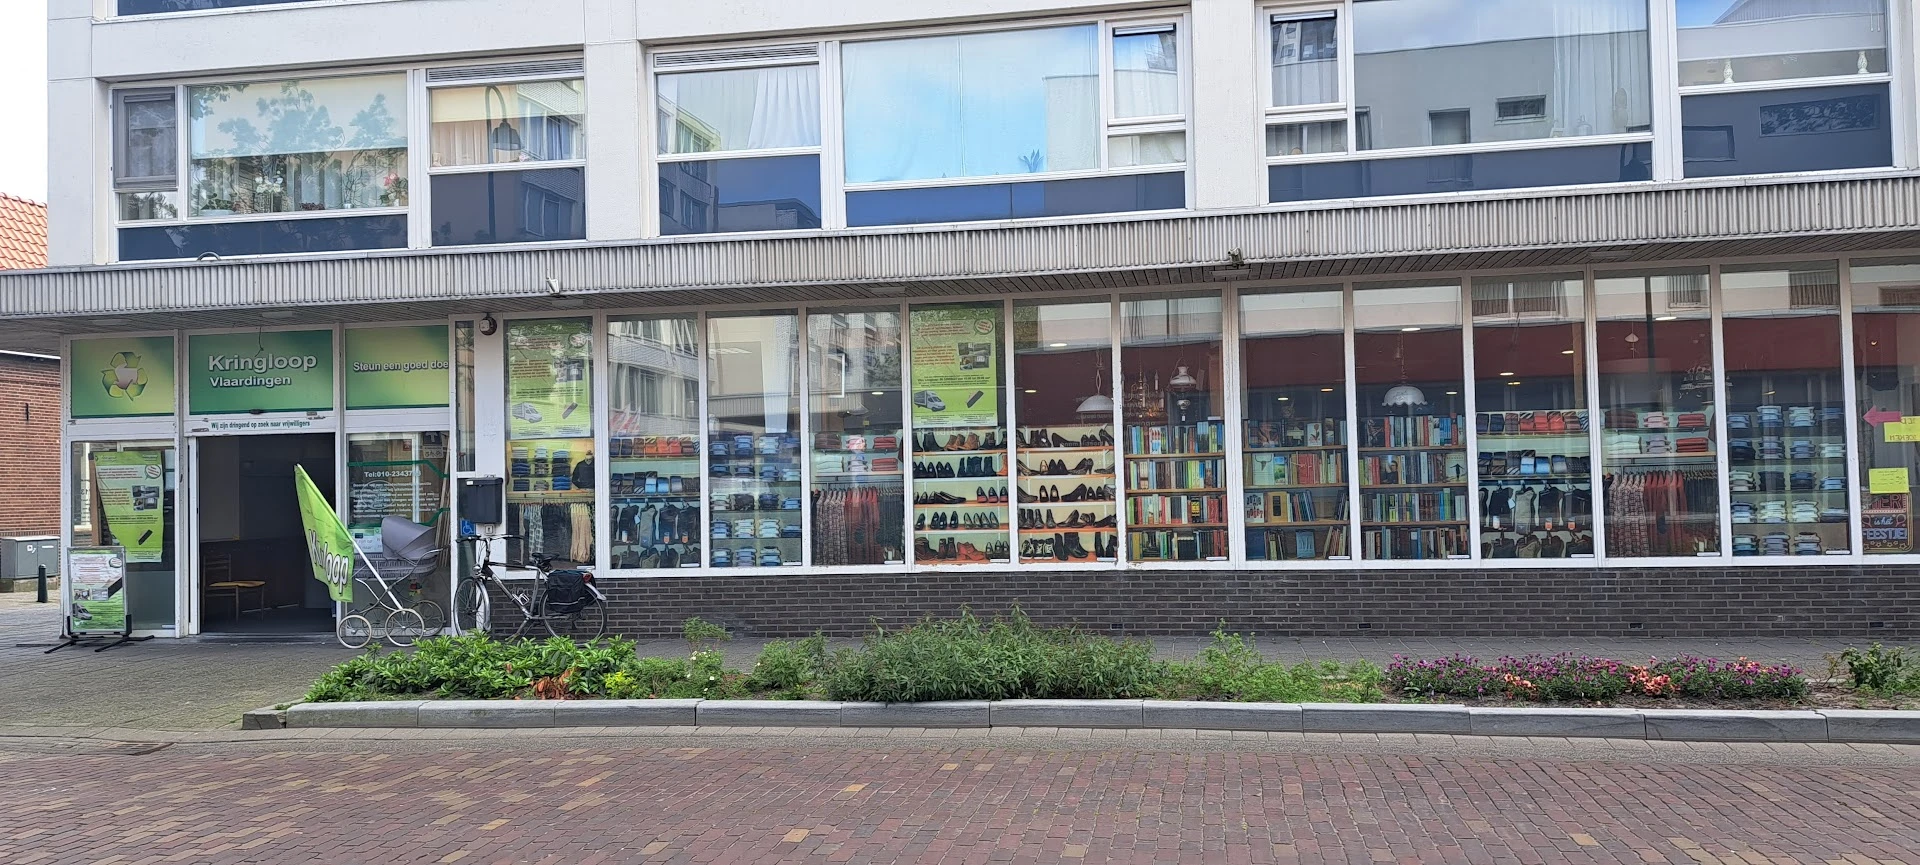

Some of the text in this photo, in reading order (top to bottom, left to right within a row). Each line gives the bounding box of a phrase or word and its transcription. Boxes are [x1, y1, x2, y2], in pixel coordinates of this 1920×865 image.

[208, 353, 317, 373] Kringloop
[353, 361, 381, 371] Steun
[383, 362, 401, 370] een
[403, 360, 428, 372] goed
[209, 375, 291, 388] Vlaardingen
[211, 422, 219, 430] Wij
[219, 422, 228, 430] zijn
[229, 421, 250, 429] dringend
[282, 420, 310, 428] vrijwilligers
[364, 470, 421, 478] Tel:010-23437
